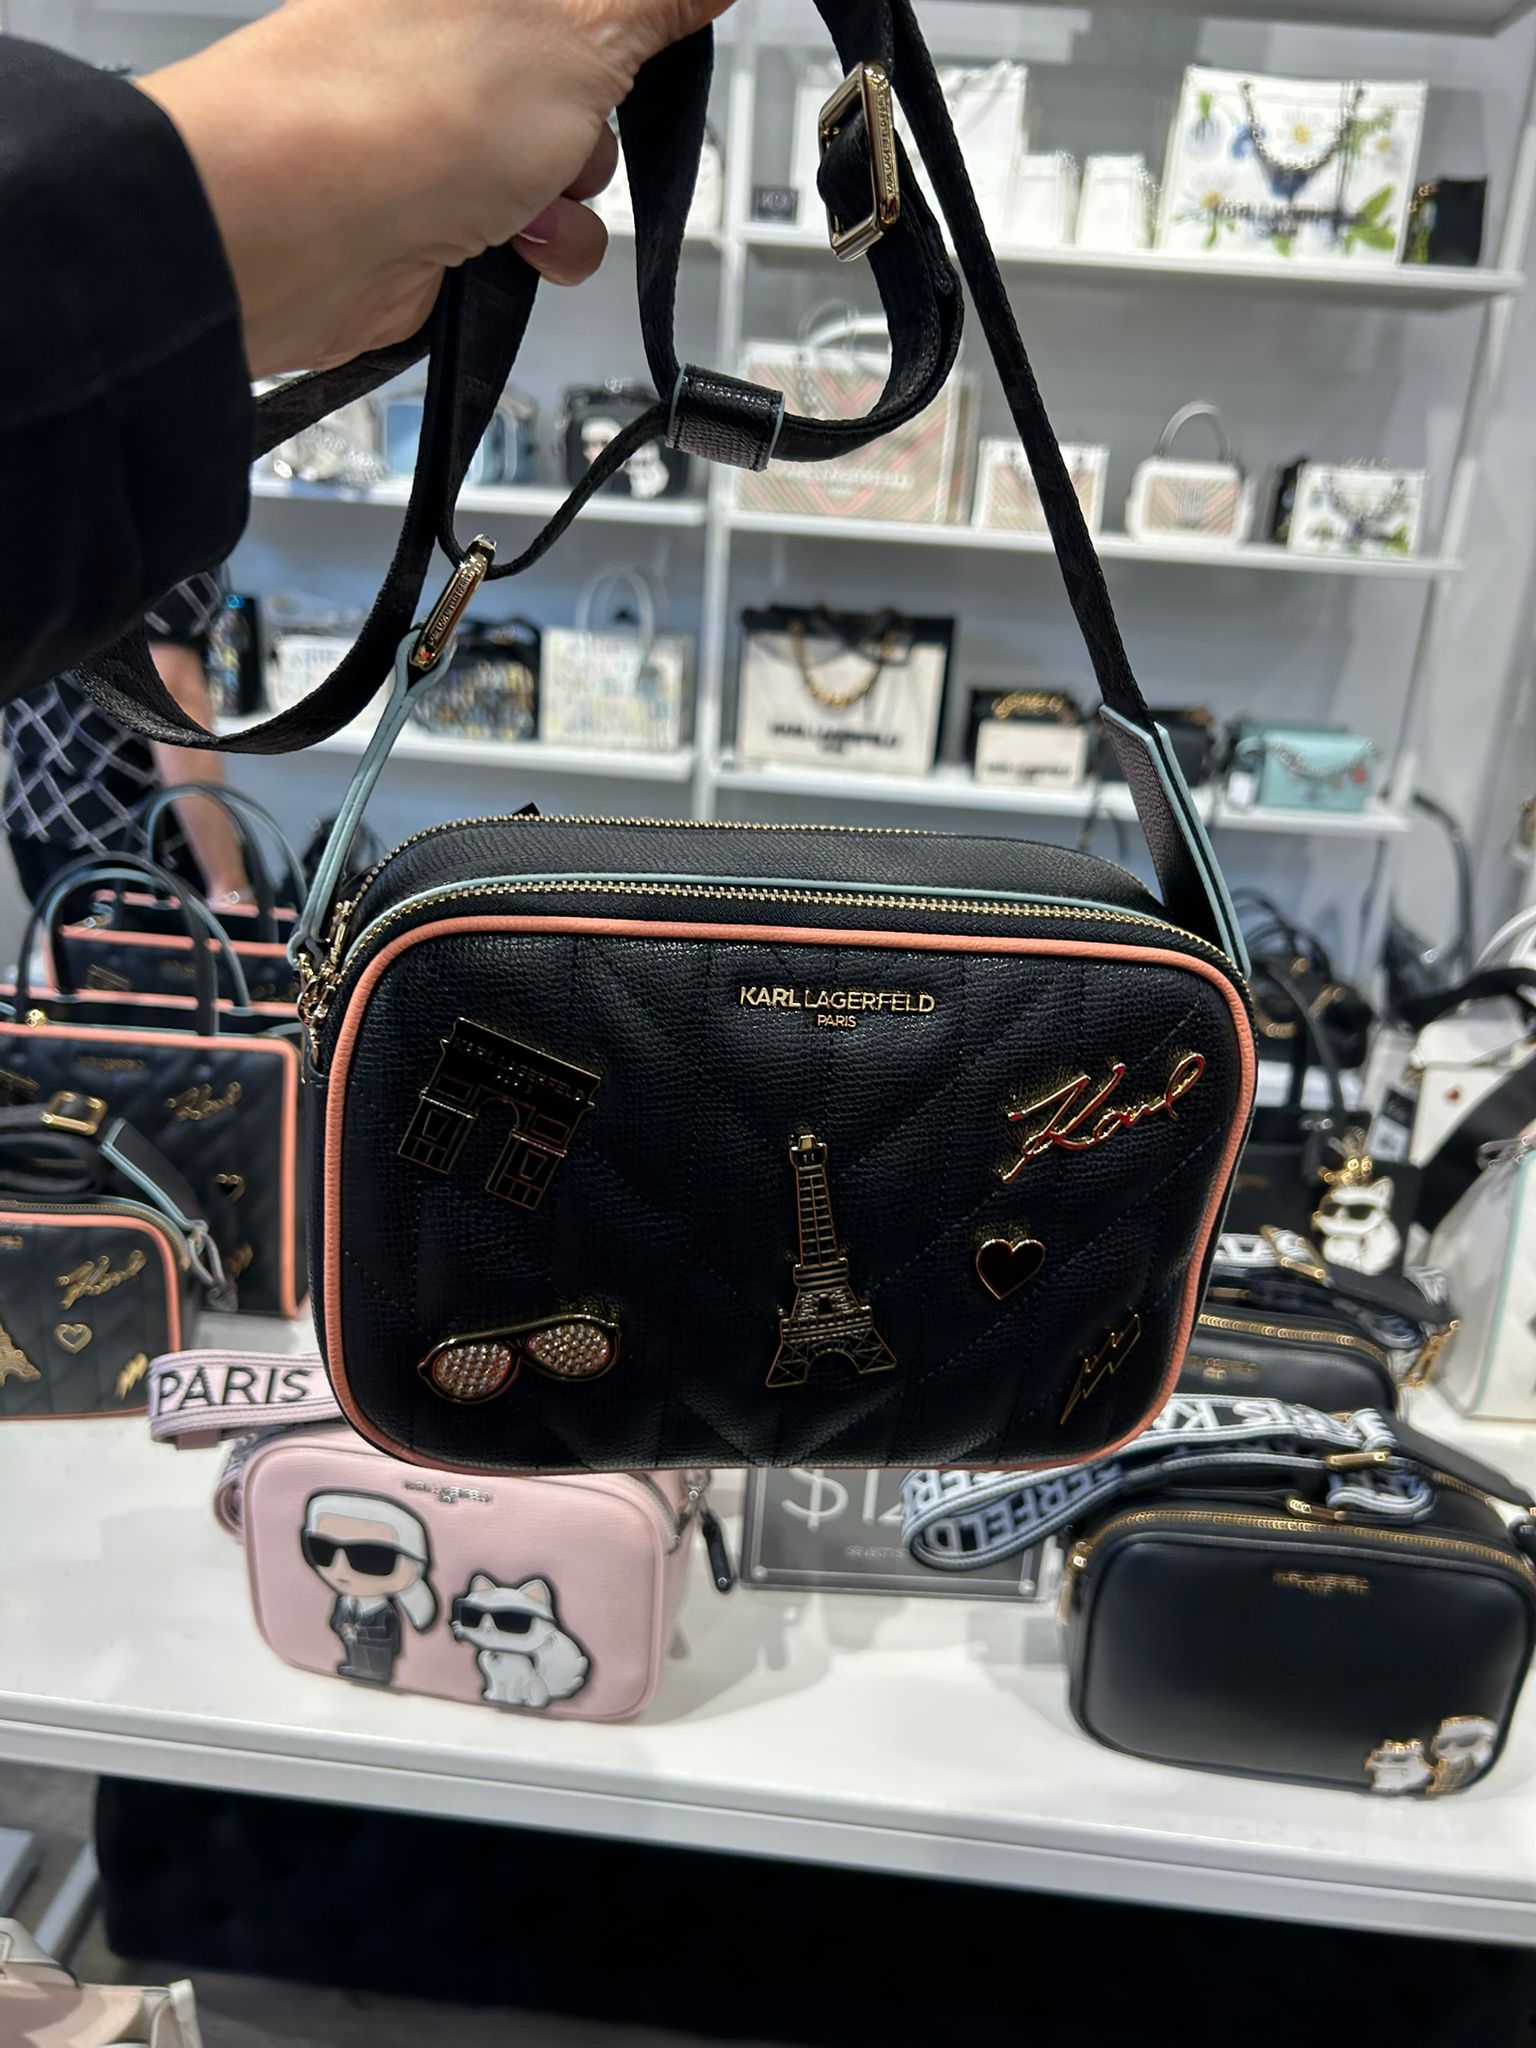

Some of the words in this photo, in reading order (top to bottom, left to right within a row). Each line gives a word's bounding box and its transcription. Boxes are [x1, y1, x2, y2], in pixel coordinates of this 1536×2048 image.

[739, 986, 801, 1008] KARL
[804, 990, 936, 1013] LAGERFELD
[817, 1014, 857, 1028] PARIS
[1002, 1053, 1206, 1185] Karl
[156, 1365, 311, 1417] PARIS
